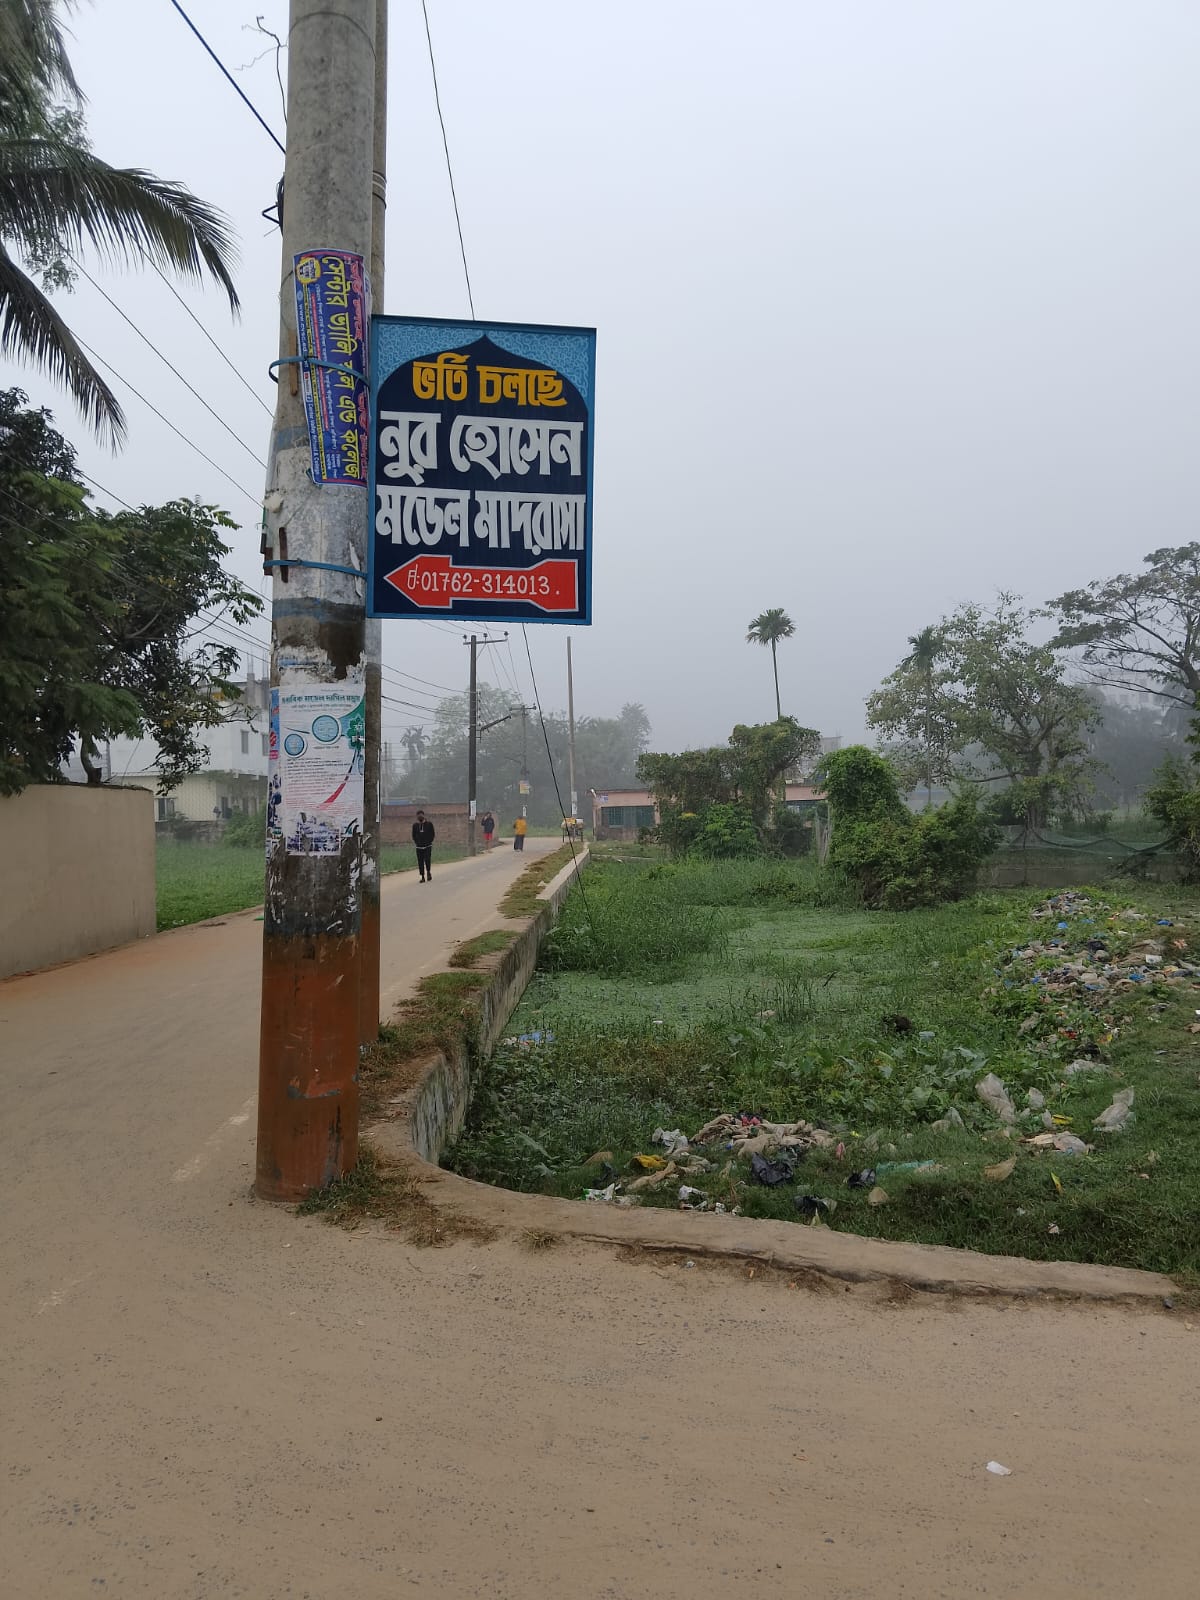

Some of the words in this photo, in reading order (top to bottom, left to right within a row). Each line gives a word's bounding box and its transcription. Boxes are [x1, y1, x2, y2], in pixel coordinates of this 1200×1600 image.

[322, 255, 352, 307] সেন্টার
[327, 312, 357, 356] ভ্যালি
[413, 352, 470, 401] ভর্তি
[476, 365, 567, 407] চলছে
[340, 428, 361, 479] কলেজ
[450, 415, 584, 481] হোসেন
[375, 484, 470, 548] মডেল
[473, 489, 587, 556] মাদরাসা
